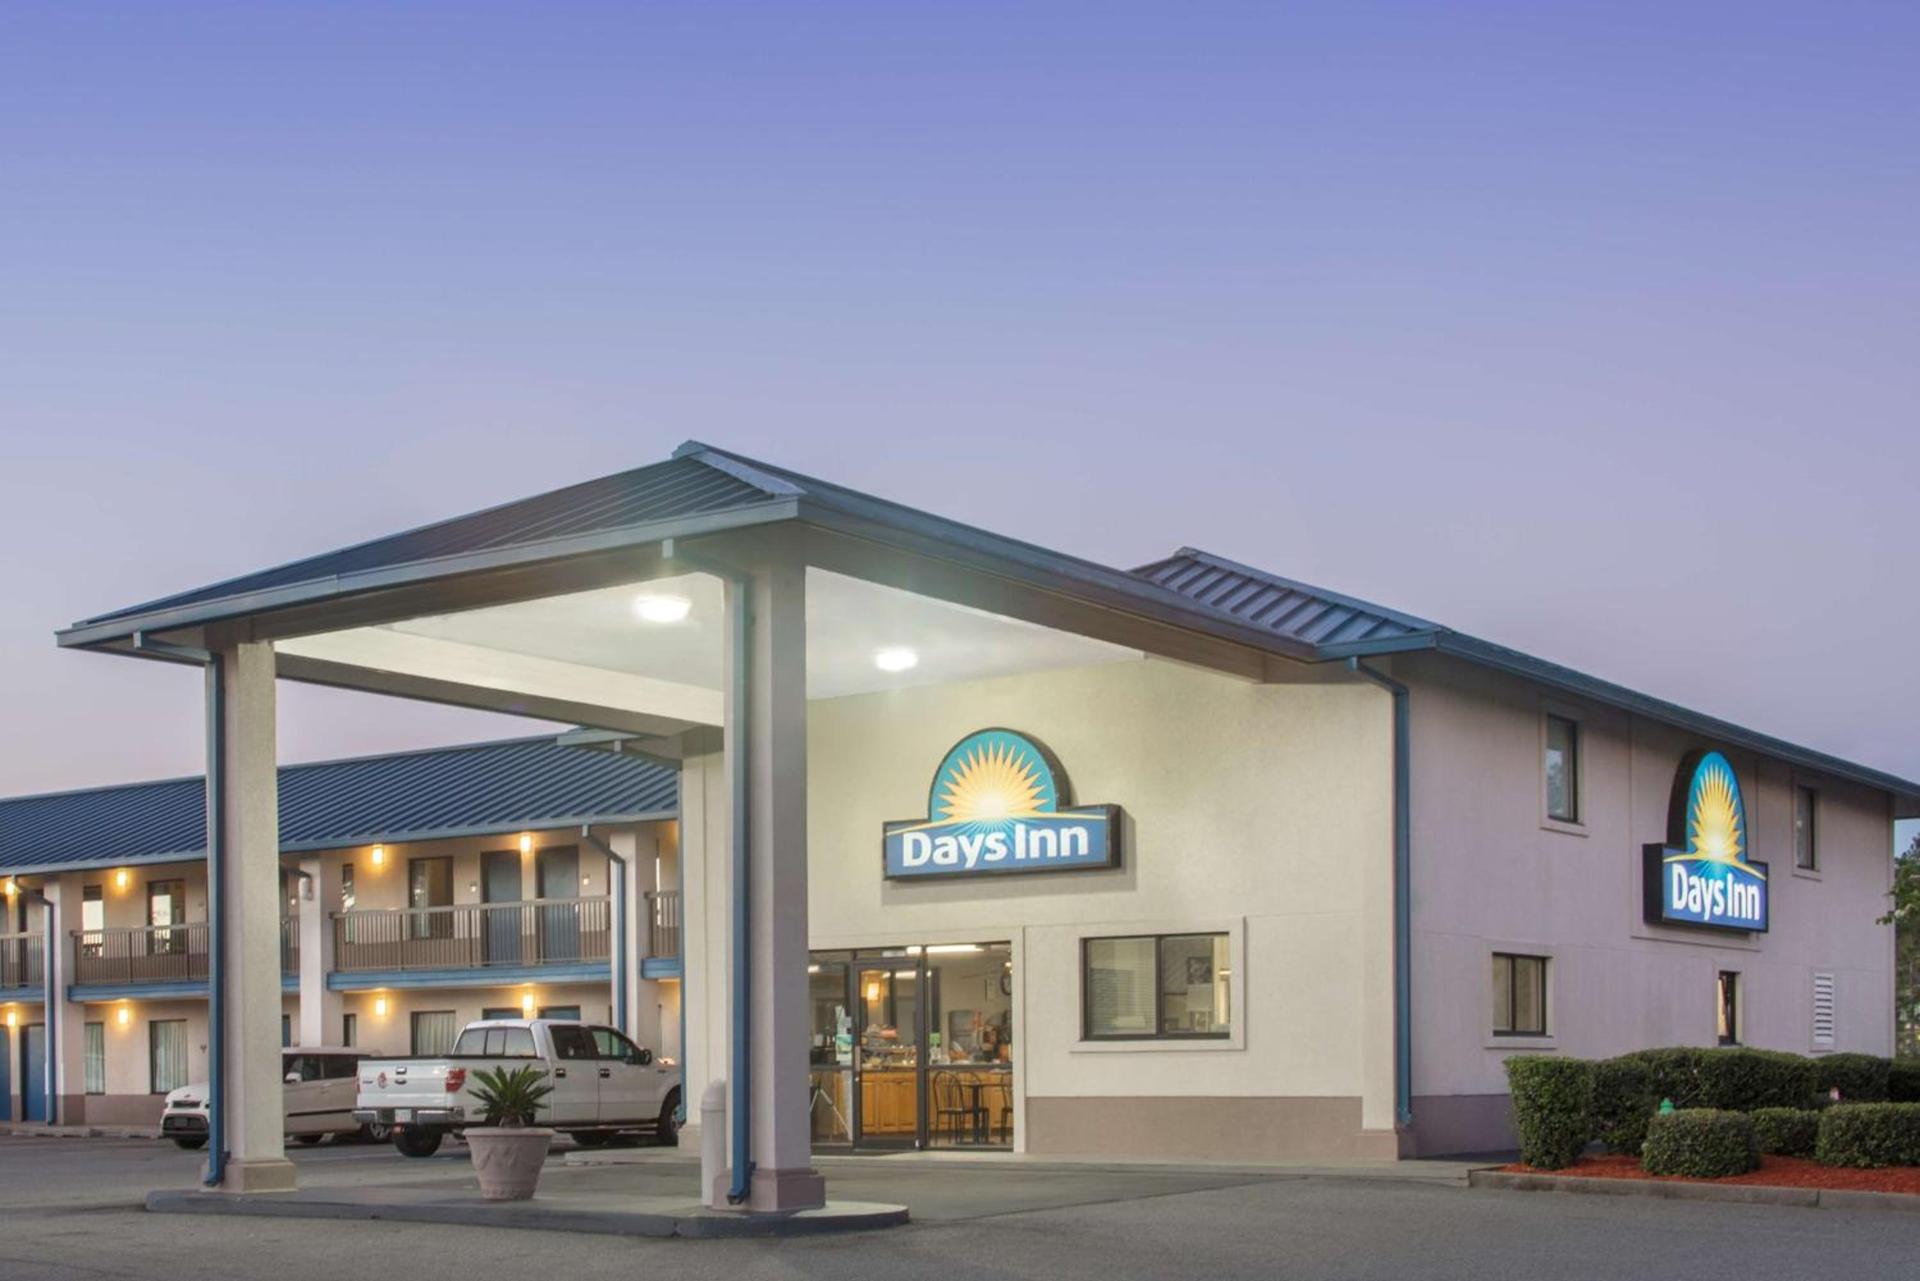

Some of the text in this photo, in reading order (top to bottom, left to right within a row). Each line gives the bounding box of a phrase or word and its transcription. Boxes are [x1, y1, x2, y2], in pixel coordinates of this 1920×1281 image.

[902, 824, 1089, 869] Days Inn
[1672, 863, 1761, 921] Days Inn
